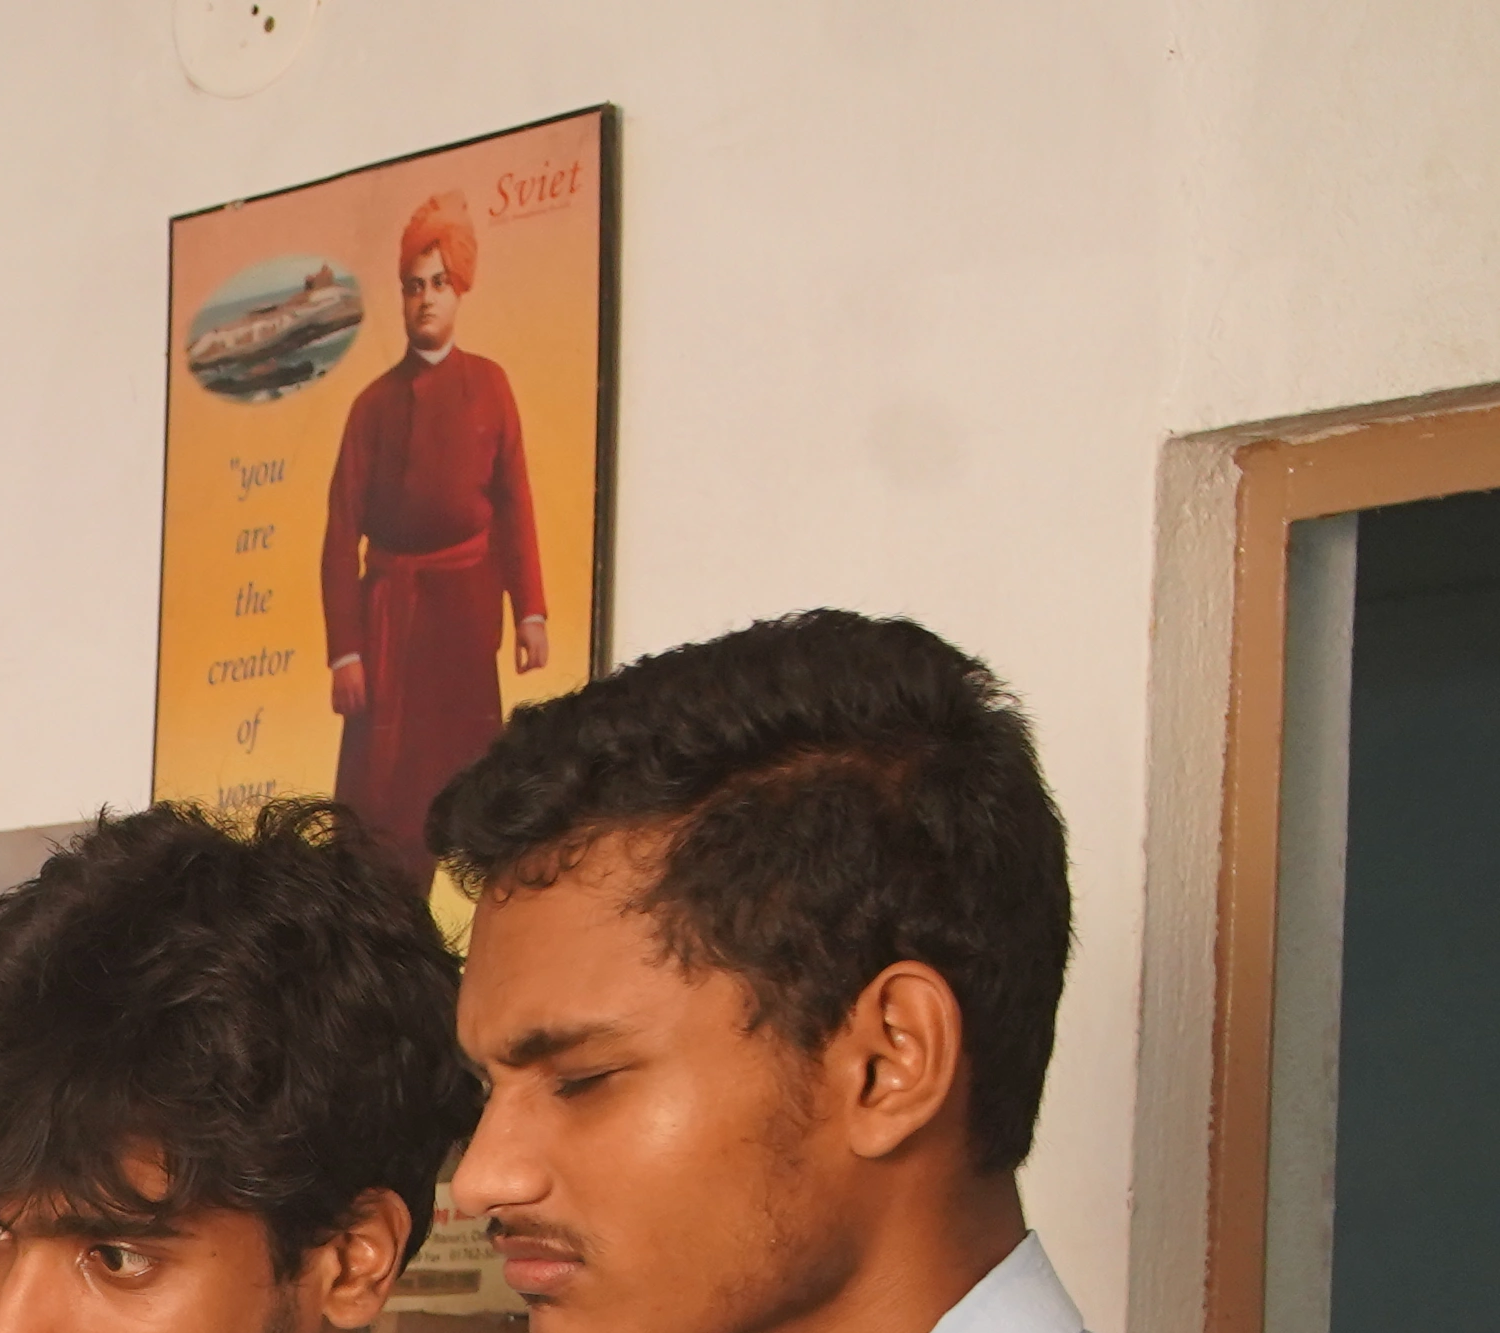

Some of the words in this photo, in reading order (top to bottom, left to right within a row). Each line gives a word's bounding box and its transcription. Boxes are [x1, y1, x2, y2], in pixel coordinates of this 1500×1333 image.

[489, 160, 583, 217] Sviet
[235, 523, 275, 554] are
[235, 581, 273, 618] the
[208, 646, 296, 685] creator
[236, 706, 265, 754] of
